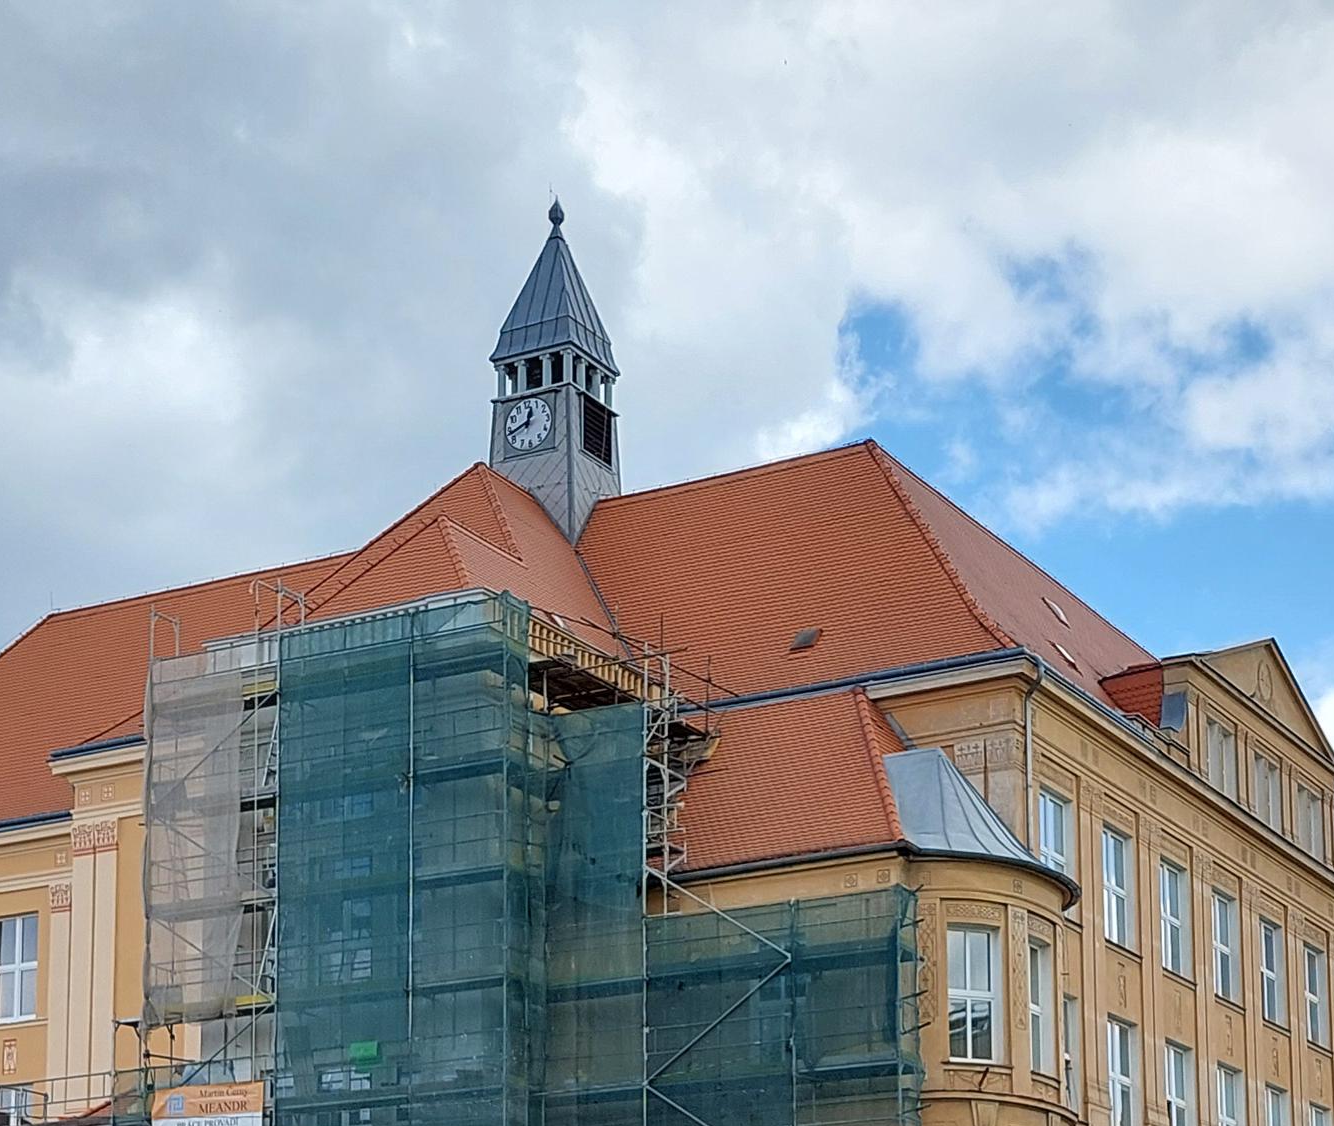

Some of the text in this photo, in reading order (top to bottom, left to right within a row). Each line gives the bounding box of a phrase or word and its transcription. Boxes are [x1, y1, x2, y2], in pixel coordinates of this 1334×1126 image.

[523, 400, 531, 409] 12
[535, 400, 538, 408] 1
[516, 406, 521, 414] 11
[541, 405, 546, 413] 2
[510, 415, 517, 423] 10
[543, 424, 547, 432] 4
[511, 436, 516, 444] 8
[537, 433, 542, 442] 5
[520, 439, 525, 448] 7
[528, 439, 532, 447] 6
[200, 1088, 225, 1097] Martin
[199, 1101, 247, 1113] MEANDR
